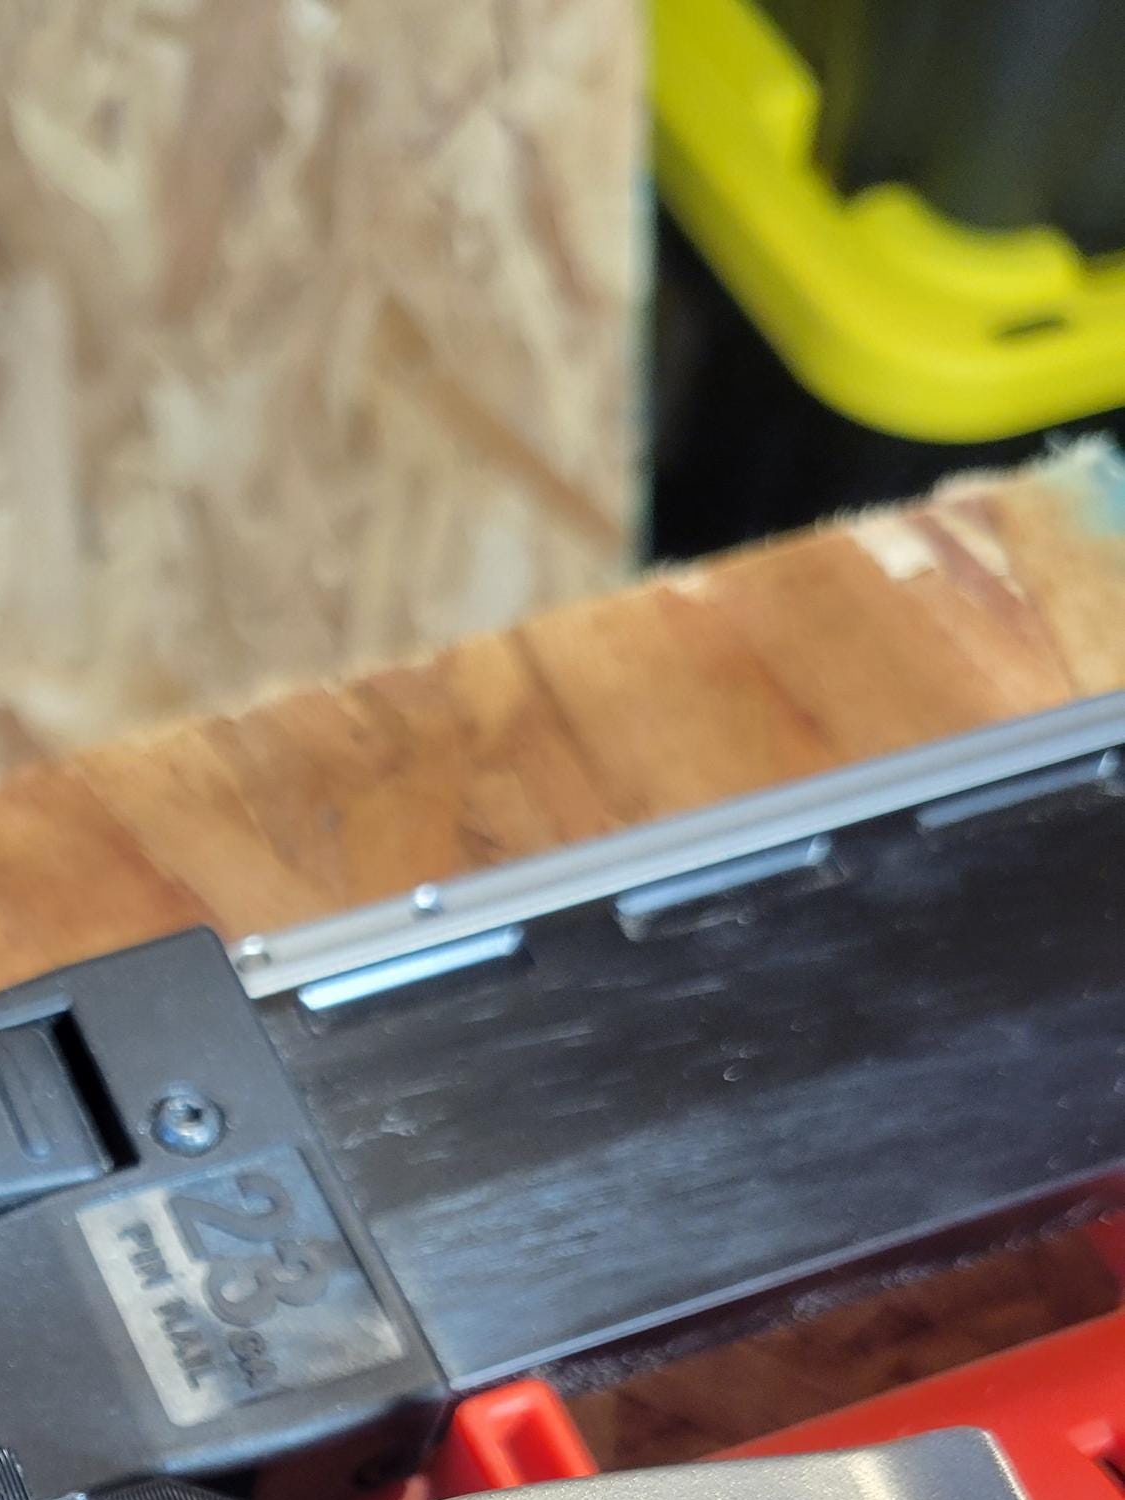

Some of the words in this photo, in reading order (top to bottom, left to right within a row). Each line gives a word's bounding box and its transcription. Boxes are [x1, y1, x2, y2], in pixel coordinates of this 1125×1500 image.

[119, 1221, 172, 1290] PIN
[154, 1298, 214, 1391] NAIL
[170, 1173, 328, 1326] 23
